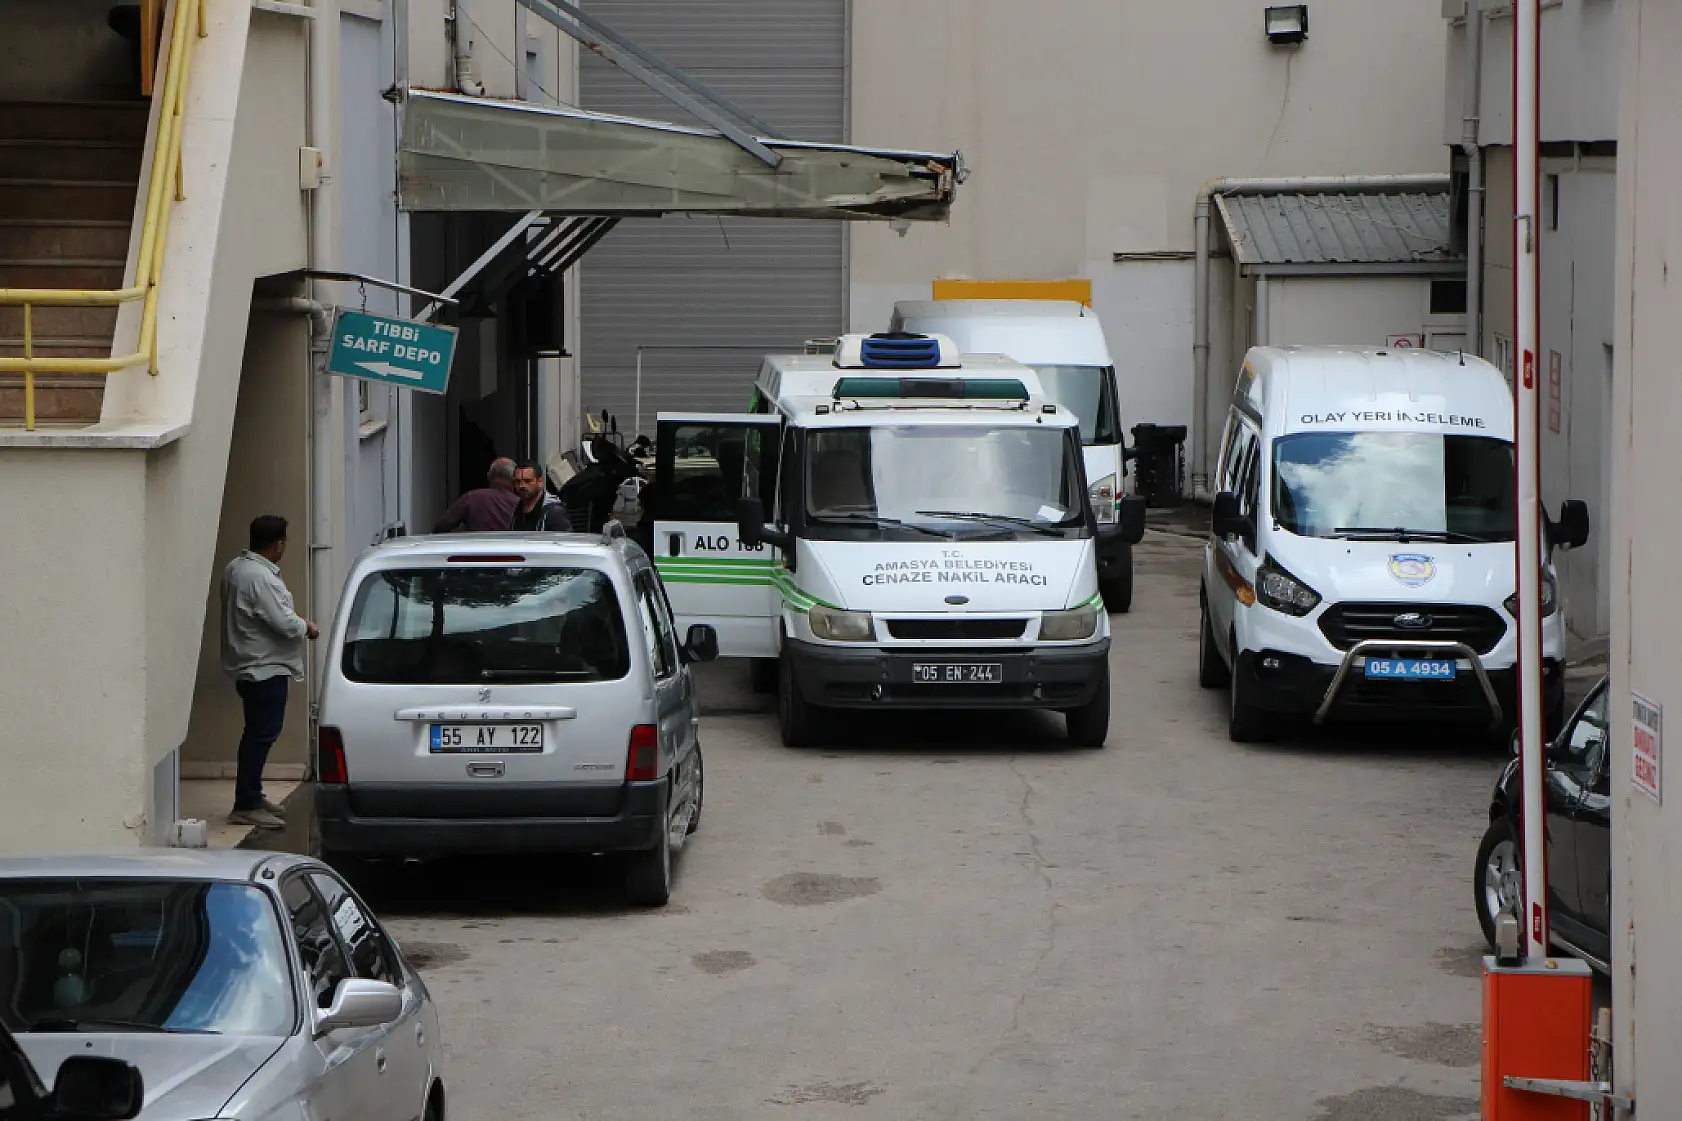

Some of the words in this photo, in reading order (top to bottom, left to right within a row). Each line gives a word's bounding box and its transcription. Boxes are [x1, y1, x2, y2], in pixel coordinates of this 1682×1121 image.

[342, 334, 391, 354] SARF
[393, 344, 441, 365] DEPO
[1301, 412, 1347, 424] OLAY
[694, 535, 730, 551] ALO
[874, 559, 940, 571] AMASYA
[862, 571, 932, 586] CENAZE
[994, 572, 1047, 586] ARACI
[921, 666, 938, 681] 05
[946, 666, 964, 681] EN
[970, 666, 993, 681] 244
[1370, 661, 1391, 674] 05
[1395, 662, 1407, 674] A
[1411, 661, 1451, 676] 4934
[442, 728, 462, 745] 55
[476, 727, 496, 745] AY
[511, 727, 540, 745] 122
